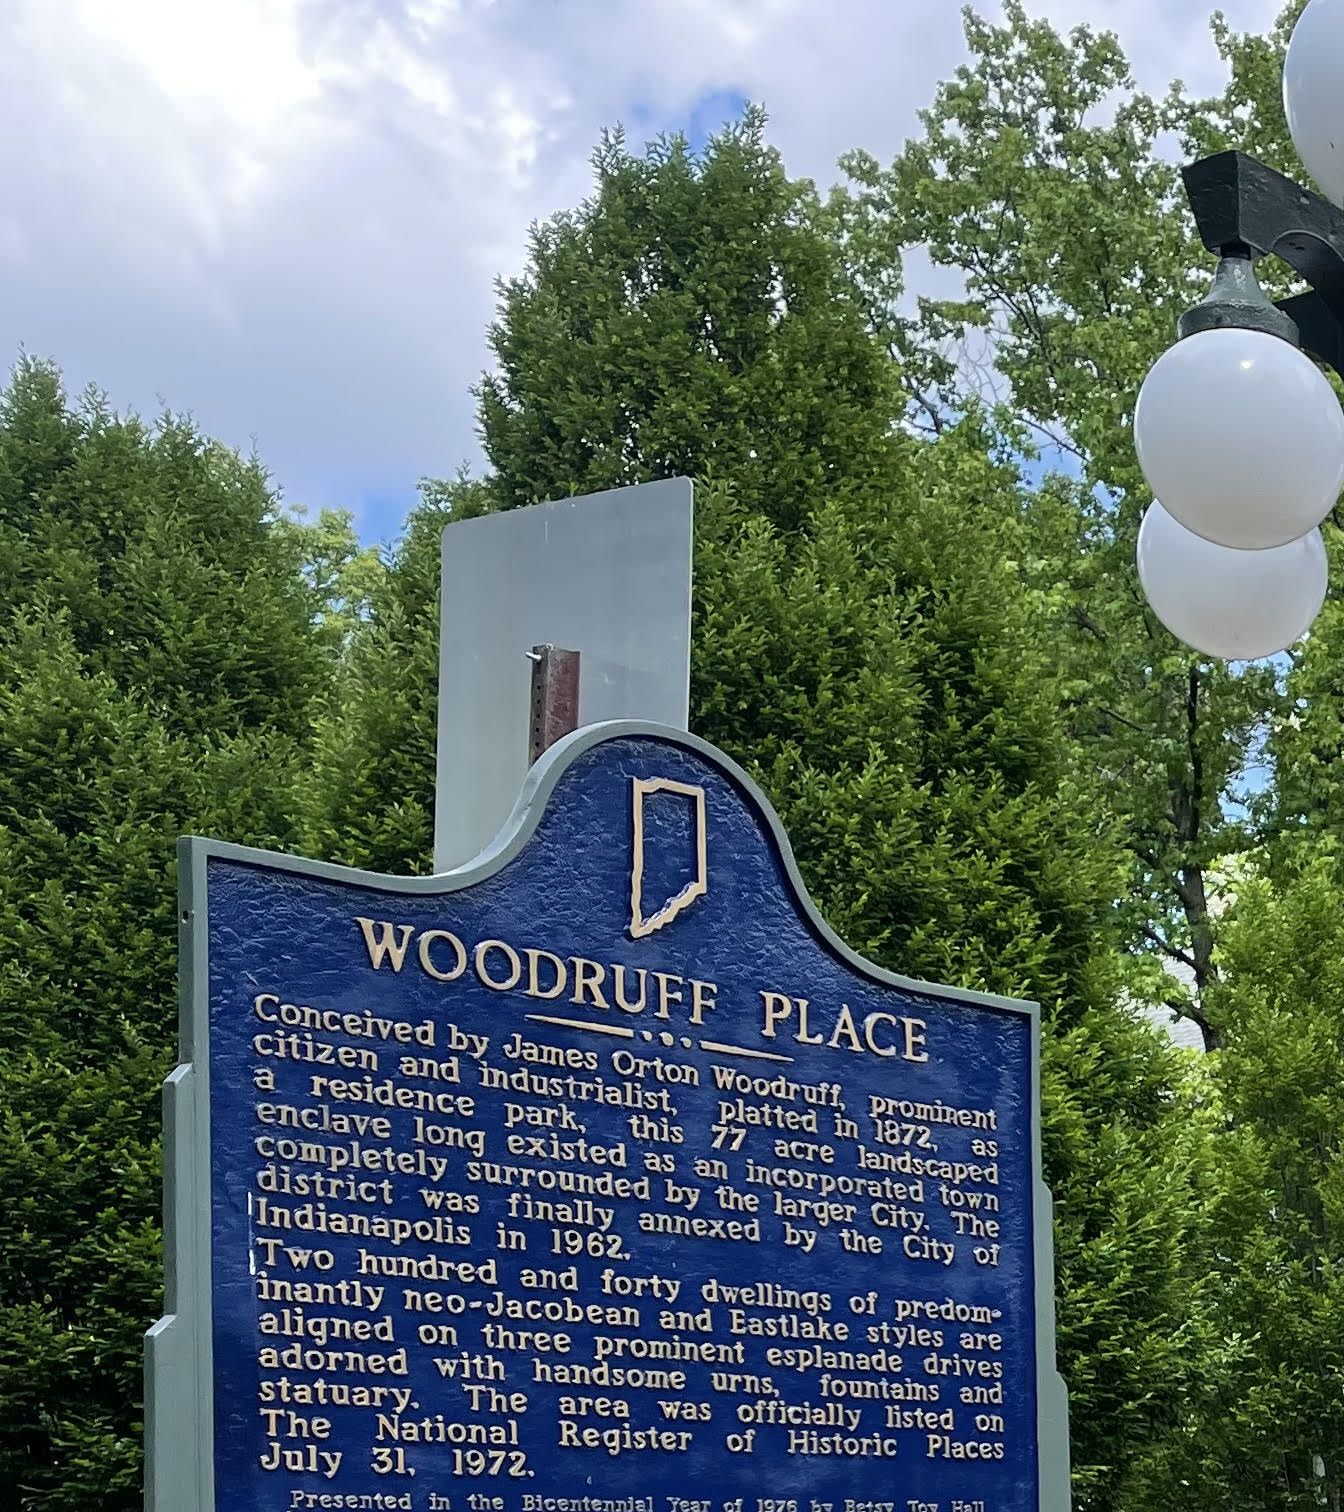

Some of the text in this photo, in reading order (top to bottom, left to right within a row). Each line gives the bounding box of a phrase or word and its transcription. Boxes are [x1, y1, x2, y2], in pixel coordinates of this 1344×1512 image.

[354, 916, 930, 1064] WOODRUFF PLACE
[253, 1032, 998, 1157] citizen and industrialist, platted in 1872, as
[255, 994, 998, 1130] Conceived by James Orton Woodruff, prominent
[254, 1067, 999, 1185] a residence park, this 77 acre landscaped
[257, 1101, 999, 1212] enclave long existed as an incorporated town
[255, 1135, 1000, 1238] completely surrounded by the larger City. The
[258, 1160, 1001, 1266] district was finally annexed by the City of
[257, 1196, 631, 1260] Indianapolis in 1962.
[256, 1236, 1002, 1324] Two hundred and forty dwellings of predom-
[257, 1276, 1002, 1351] inantly neo-Jacobean and Eastlake styles are
[259, 1341, 1003, 1404] adorned with handsome urns, fountains and
[260, 1307, 1003, 1378] aligned on three prominent esplanade drives
[259, 1375, 1004, 1432] statuary. The area was officially listed on
[260, 1407, 1004, 1459] The National Register of Historic Places
[261, 1441, 535, 1479] July 31, 1972.
[291, 1489, 413, 1512] Presented
[429, 1491, 450, 1510] in
[467, 1492, 504, 1511] the
[523, 1493, 653, 1512] Bicentennial
